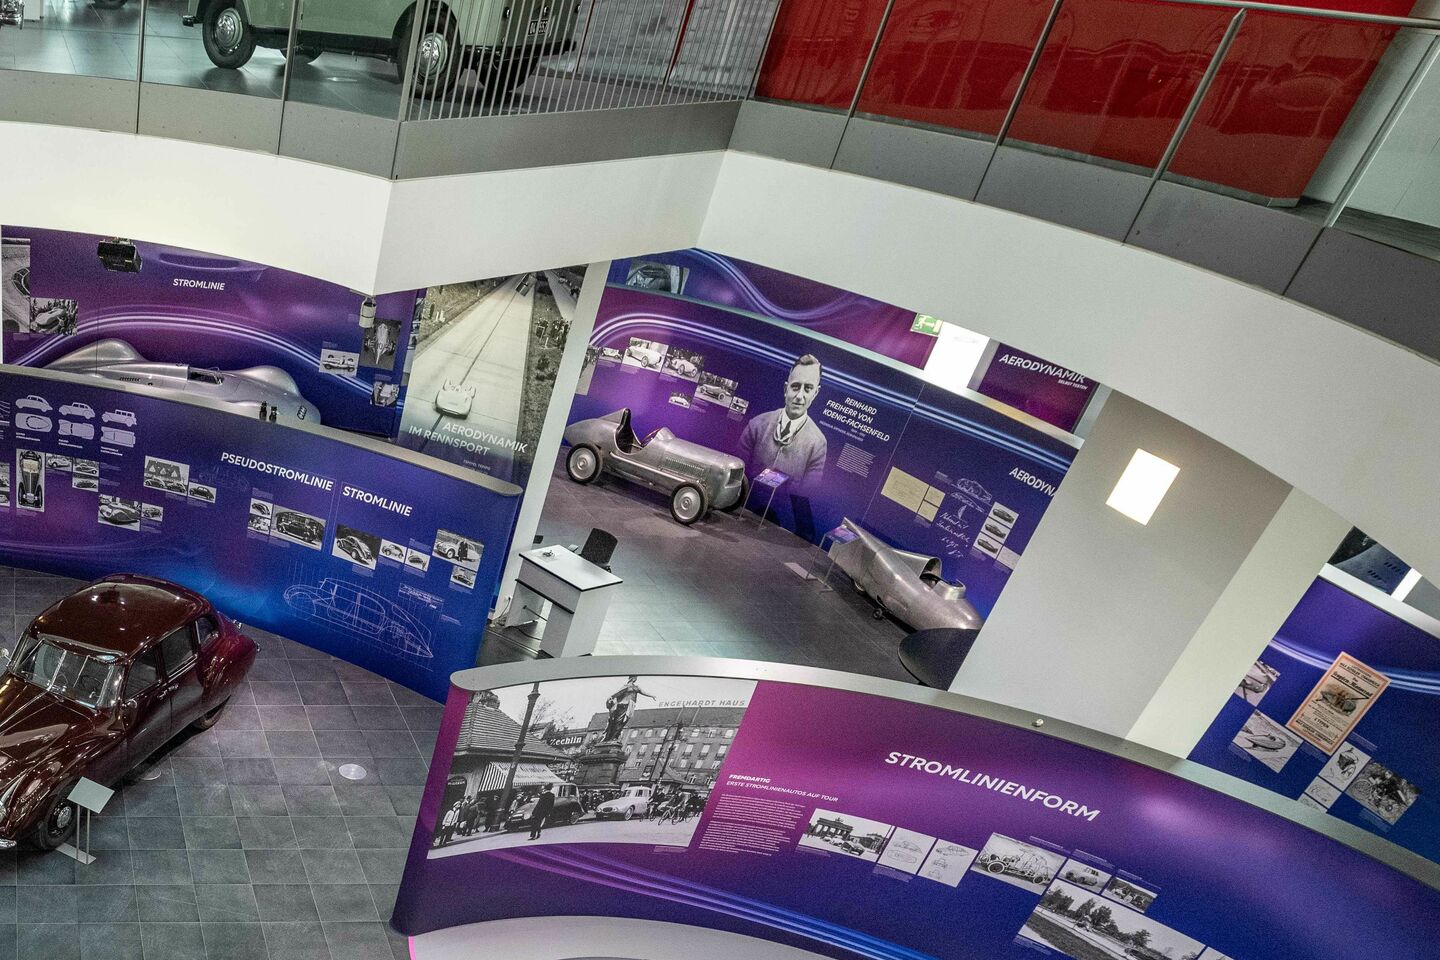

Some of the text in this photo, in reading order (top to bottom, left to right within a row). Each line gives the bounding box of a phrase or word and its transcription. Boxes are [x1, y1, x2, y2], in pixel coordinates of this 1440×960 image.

[172, 278, 226, 291] STROMLINIE
[999, 353, 1086, 384] AERODYNAMIK
[826, 399, 874, 424] FREIHERR VON
[844, 396, 878, 415] REINHARD
[442, 422, 528, 454] AERODYNAMIK
[822, 407, 891, 442] KOENIG-FACHSENFELD
[408, 425, 491, 456] IM RENNSPORT
[220, 451, 334, 492] PSEUDOSTROMLINIE
[1008, 467, 1057, 497] AERODYN
[342, 485, 413, 517] STROMLINIE
[658, 699, 716, 708] ENGELHARDT
[726, 780, 839, 802] ERSTE STROMLINIENAUTOS AUF TOUR
[728, 774, 771, 784] FREMDARTIG
[884, 751, 1101, 822] STROMLINIENFORM
